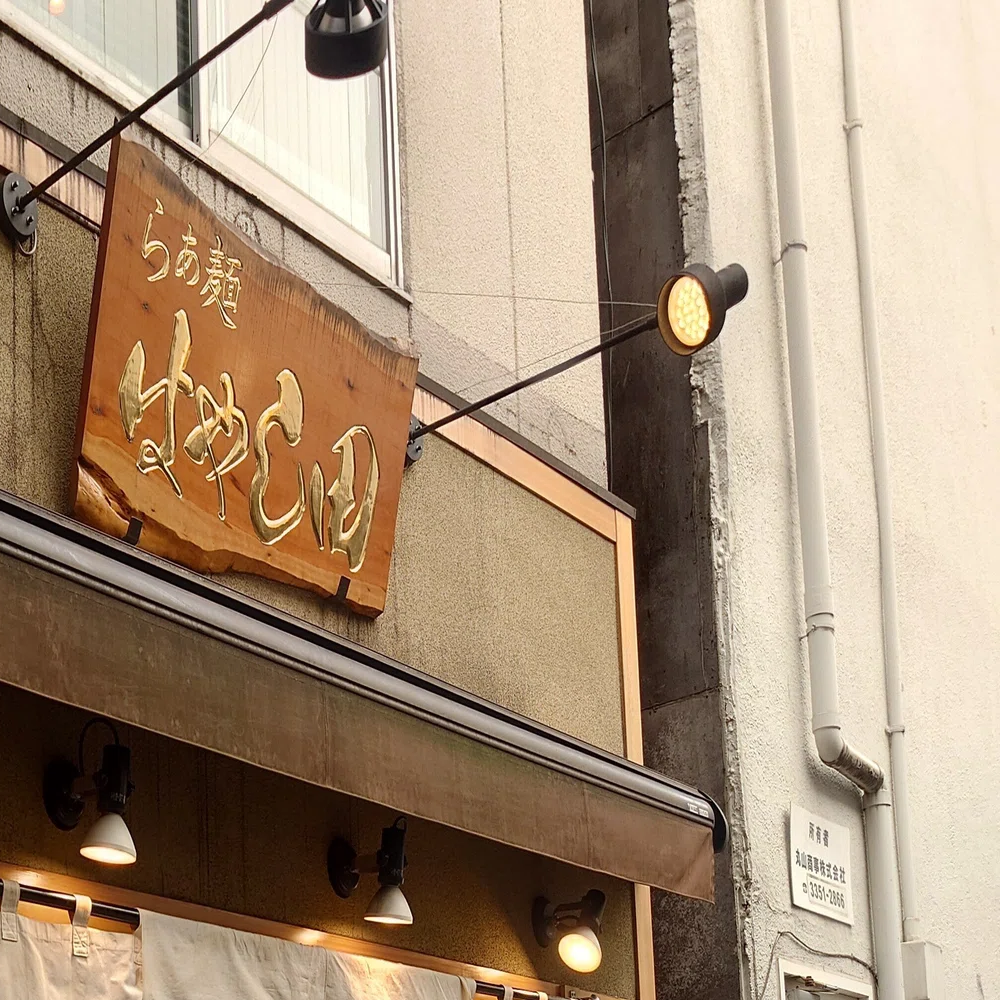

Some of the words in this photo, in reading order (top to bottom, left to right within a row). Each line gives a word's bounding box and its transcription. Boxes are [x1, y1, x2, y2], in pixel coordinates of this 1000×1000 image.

[808, 822, 829, 848] 所有者
[809, 881, 846, 909] 3351-2866
